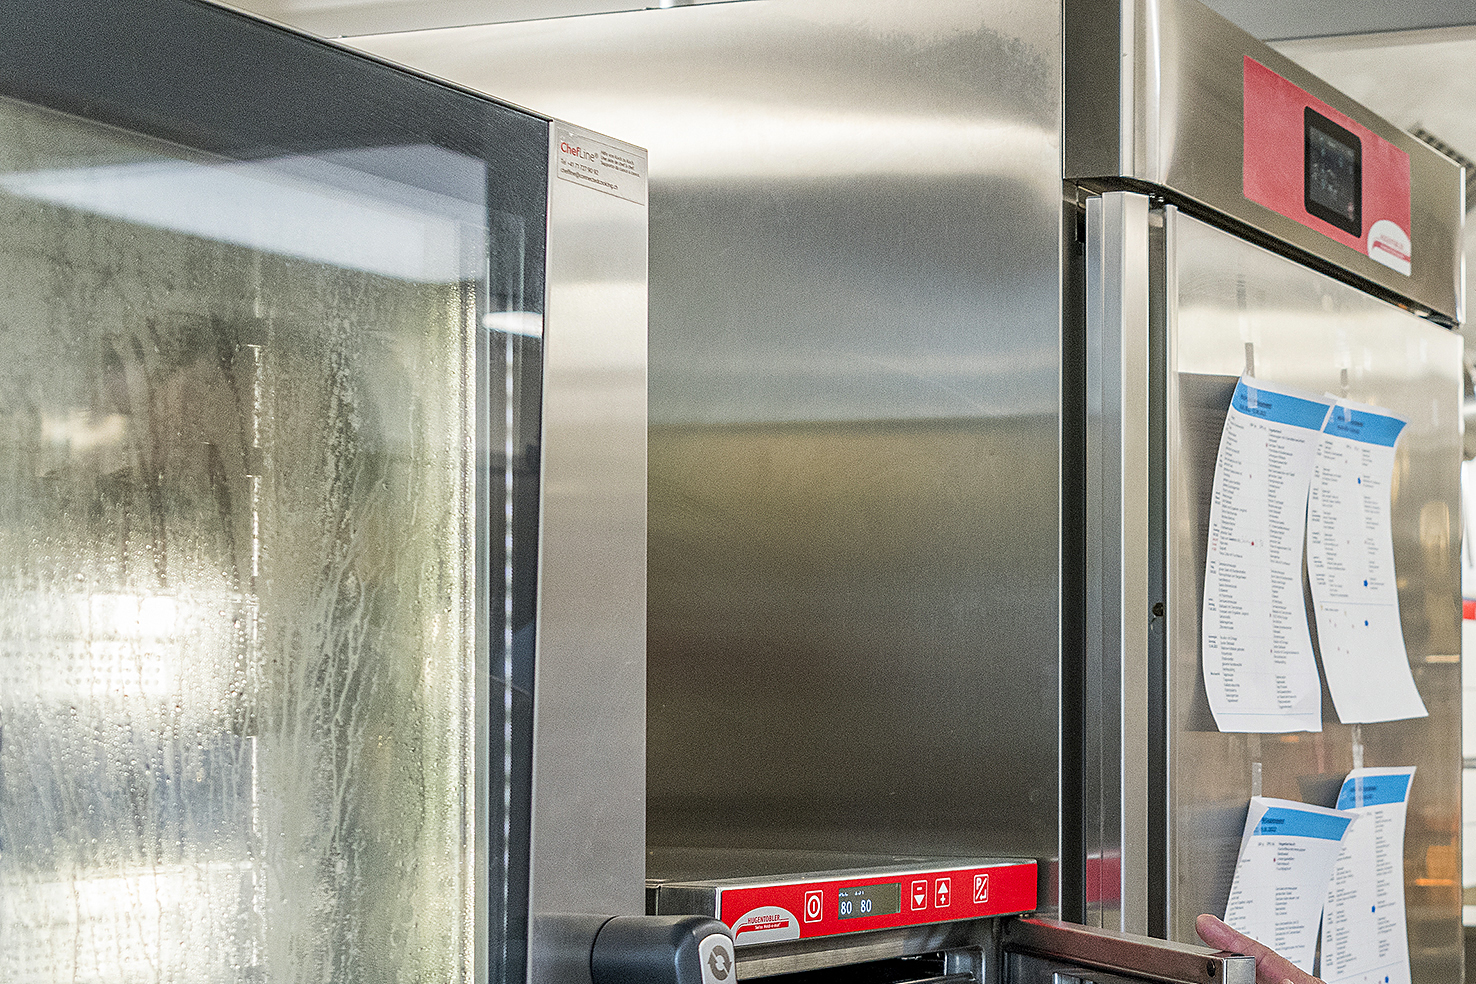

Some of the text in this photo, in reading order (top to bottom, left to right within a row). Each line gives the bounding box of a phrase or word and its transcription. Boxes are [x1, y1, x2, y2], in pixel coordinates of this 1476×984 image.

[841, 899, 872, 915] 80 80
[748, 915, 780, 924] HUGENTOBLER
